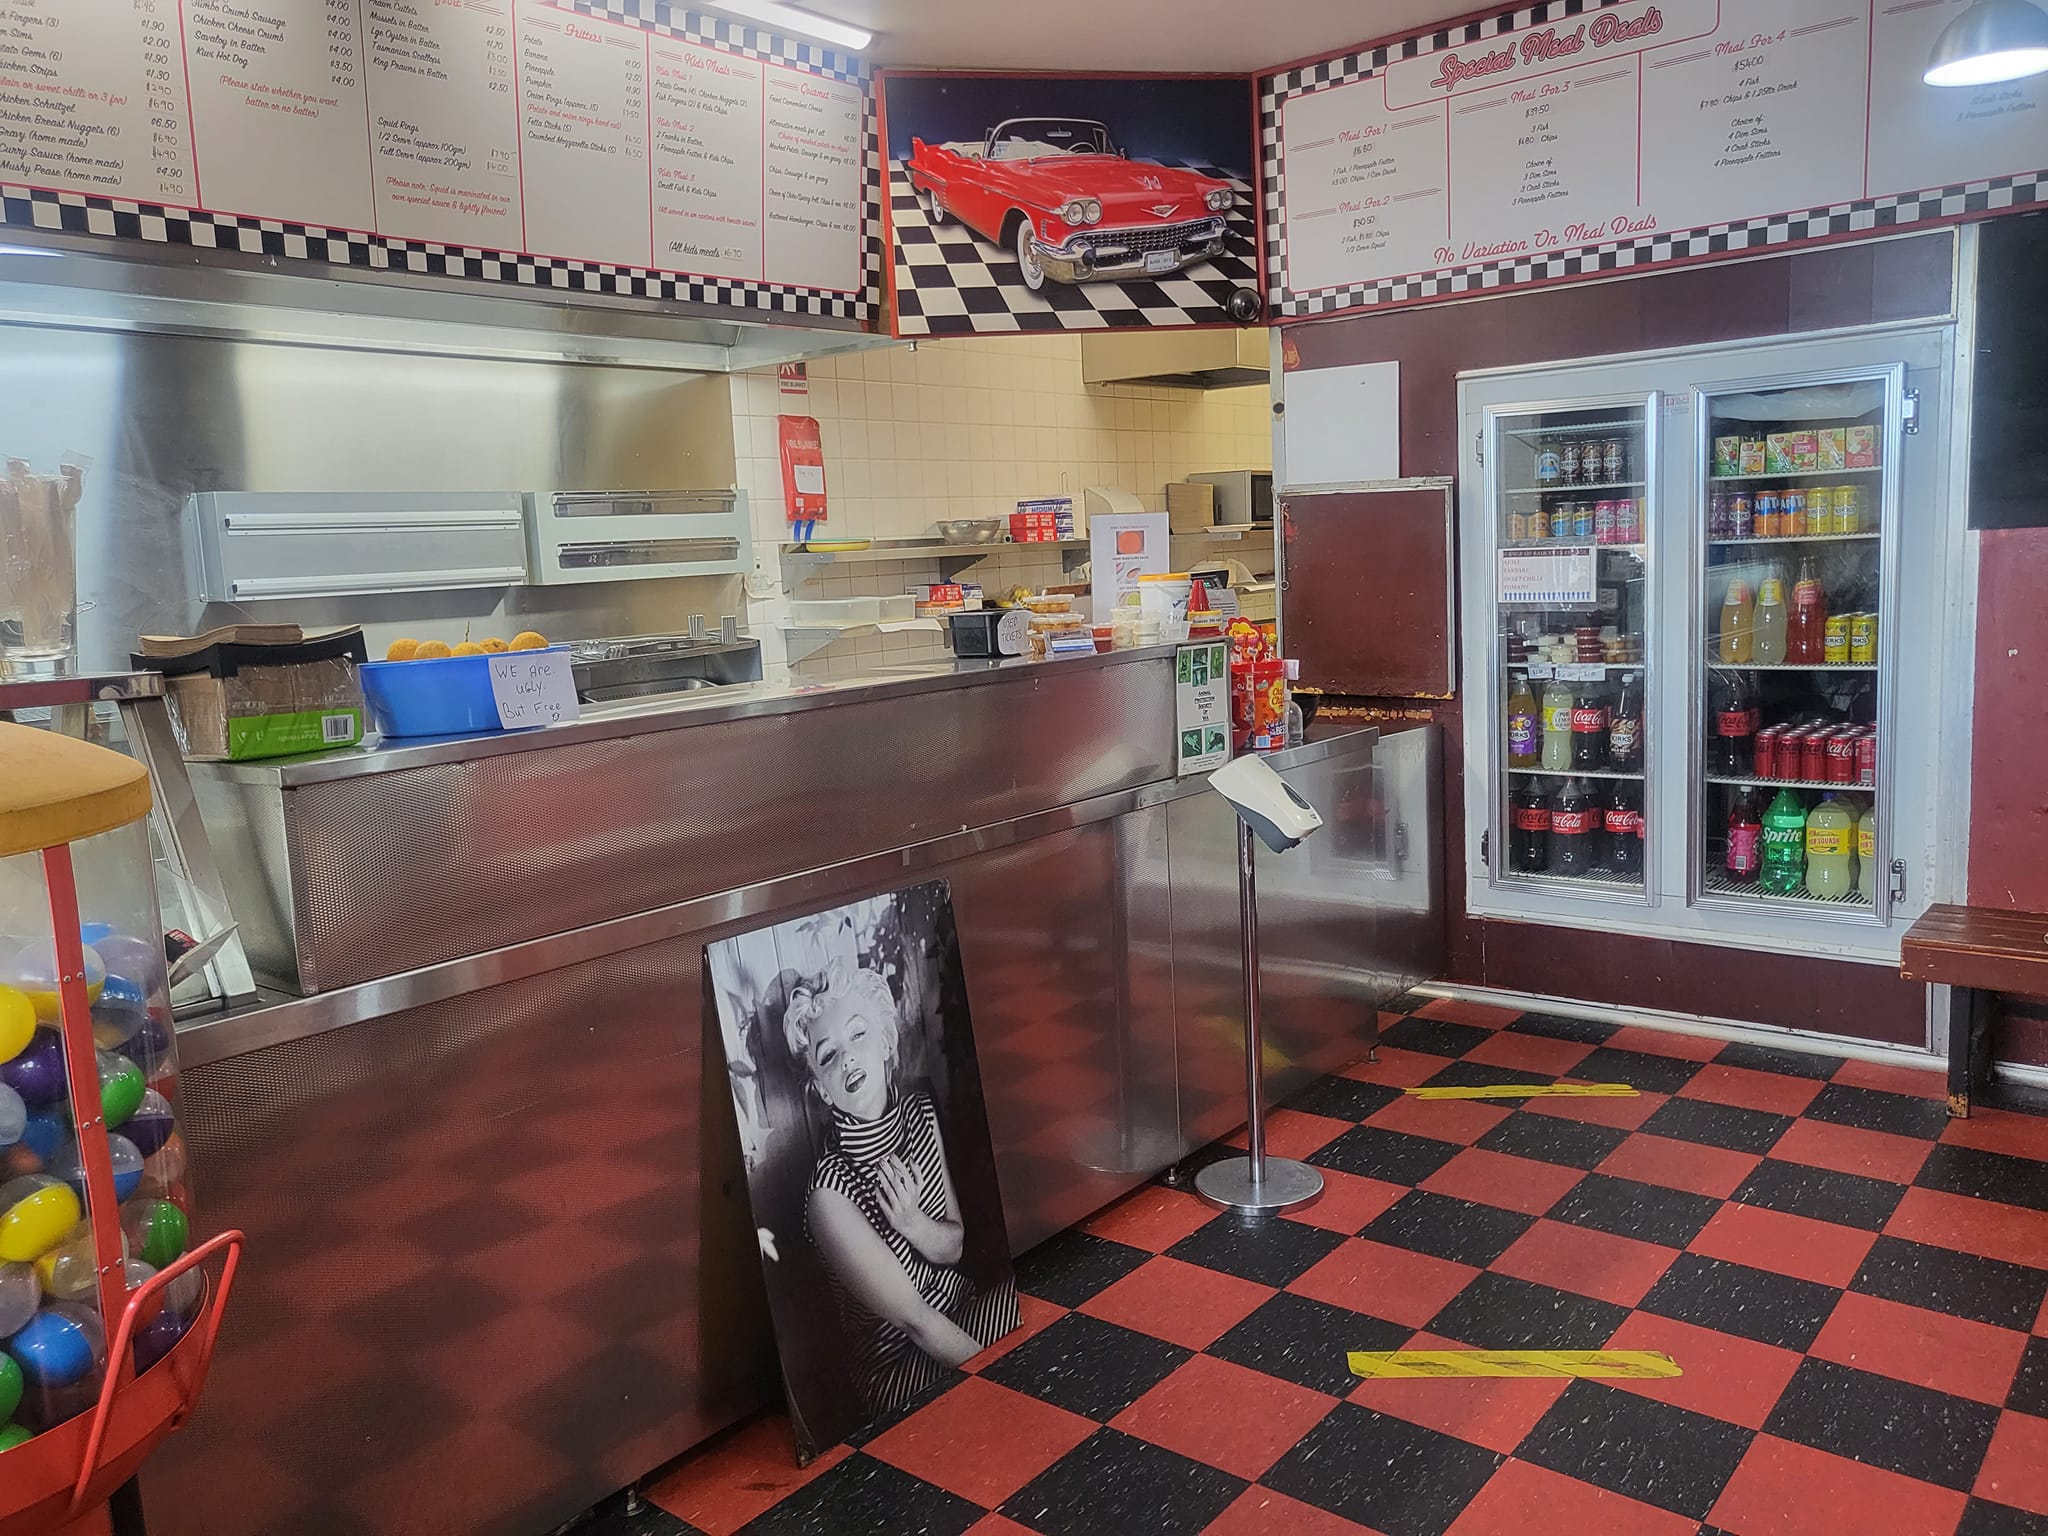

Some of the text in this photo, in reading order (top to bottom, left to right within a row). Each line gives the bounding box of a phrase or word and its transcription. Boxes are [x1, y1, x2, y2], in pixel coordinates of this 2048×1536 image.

[222, 4, 286, 29] Crumb Sausage
[394, 1, 418, 15] Cutlets
[9, 12, 59, 28] Fingers (3)
[193, 14, 284, 42] Chicken Cheese Crumb
[327, 14, 350, 26] $4.00
[370, 12, 397, 25] Mussels
[408, 19, 429, 33] Batter
[11, 28, 33, 40] Sims
[328, 29, 351, 42] $4.00
[385, 29, 409, 43] Oyster
[419, 37, 440, 50] Batter
[524, 34, 543, 46] Potato
[564, 23, 602, 42] Fritters
[143, 36, 170, 48] $2.00
[194, 30, 266, 54] Savaloy in Batter
[1429, 6, 1663, 91] Special Meal Deals
[1714, 29, 1786, 57] Meal For 4
[21, 47, 62, 62] Gems (6)
[196, 47, 248, 69] Kiwi Hot Dog
[329, 45, 352, 57] $4.00
[372, 41, 441, 64] Tasmanian Scallops
[524, 49, 548, 61] Banana
[29, 64, 58, 77] Strips
[330, 60, 353, 72] $3.50
[373, 57, 388, 70] King
[391, 60, 417, 74] Prawns
[427, 67, 448, 80] Batter
[525, 62, 555, 76] Pineapple
[684, 53, 730, 76] Kids Meals
[36, 84, 61, 94] sweet
[331, 75, 355, 87] $4.00
[525, 76, 552, 89] Pumpkin
[220, 75, 338, 107] (Please state whether you want
[1510, 81, 1570, 104] Meal For 3
[33, 97, 76, 114] Schnitzel
[245, 96, 269, 109] batter
[294, 105, 320, 118] batter)
[34, 113, 120, 137] Breast Nuggets (6)
[151, 118, 177, 129] $6.50
[377, 117, 419, 133] Squid Rings
[29, 130, 88, 148] (home made)
[378, 131, 391, 141] 1/2
[392, 133, 412, 145] Serve
[1338, 131, 1361, 143] Meal
[1363, 125, 1381, 138] For
[66, 152, 93, 165] (home
[95, 159, 124, 169] made)
[379, 145, 395, 157] Full
[395, 149, 415, 160] Serve
[444, 157, 471, 171] 200gm)
[1, 160, 122, 185] Mushy Pease (home made)
[1339, 195, 1391, 214] Meal For 2
[1434, 214, 1657, 265] No Variation On Meal Deals
[684, 243, 698, 257] kids
[699, 246, 721, 258] meals
[495, 664, 552, 679] WE Are
[502, 702, 561, 719] But Free
[1612, 735, 1632, 743] KIRKS
[1762, 827, 1802, 844] Sprite
